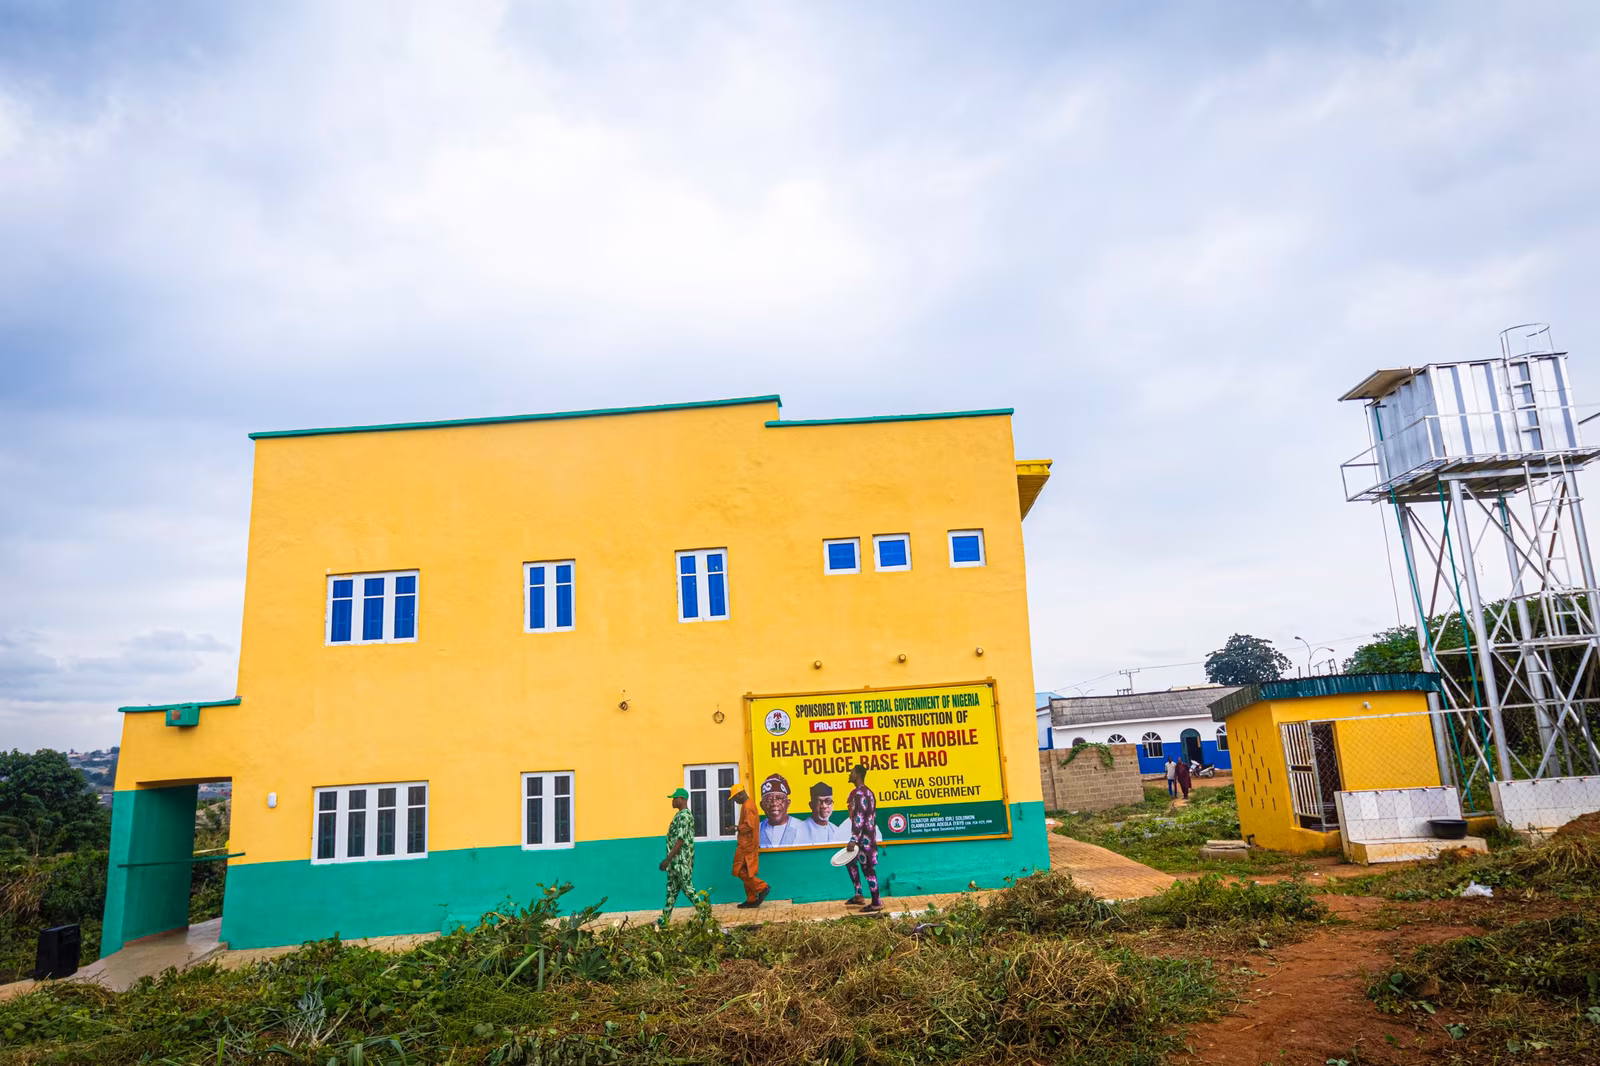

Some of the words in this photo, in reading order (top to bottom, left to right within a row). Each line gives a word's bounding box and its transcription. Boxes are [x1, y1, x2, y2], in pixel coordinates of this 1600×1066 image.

[796, 702, 835, 718] SPONSORED
[837, 702, 848, 716] BY:
[850, 700, 862, 714] THE
[864, 698, 892, 713] FEDERAL
[894, 696, 940, 712] GOVERNMENT
[942, 695, 950, 708] OF
[952, 693, 980, 708] NIGERIA
[814, 720, 848, 730] PROJECT
[849, 719, 868, 728] TITLE
[878, 711, 952, 728] CONSTRUCTION
[956, 710, 968, 724] OF
[770, 739, 826, 758] HEALTH
[832, 734, 890, 754] CENTRE
[896, 733, 915, 750] AT
[921, 729, 978, 748] MOBILE
[803, 756, 853, 775] POLICE
[859, 754, 899, 771] BASE
[905, 750, 948, 768] ILARO
[893, 778, 924, 789] YEWA
[928, 775, 964, 786] SOUTH
[879, 790, 912, 802] LOCAL
[916, 785, 981, 799] GOVERMENT
